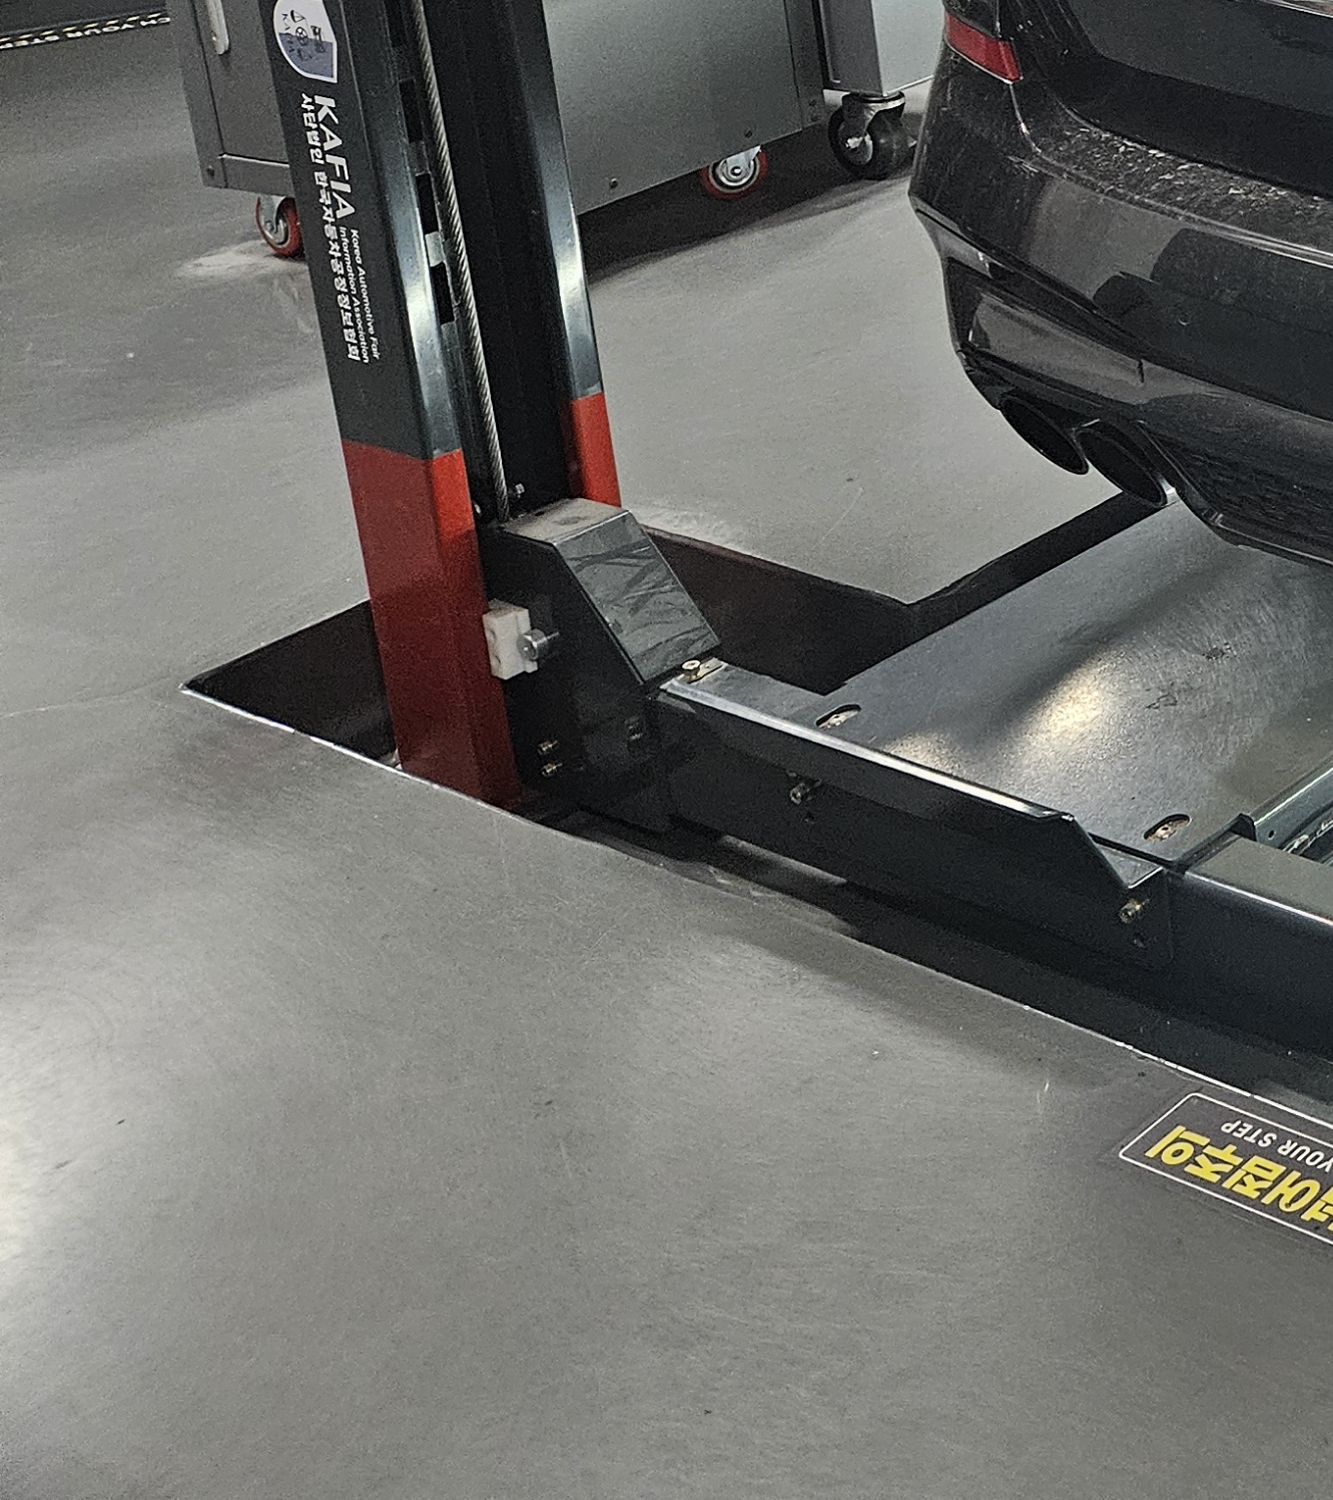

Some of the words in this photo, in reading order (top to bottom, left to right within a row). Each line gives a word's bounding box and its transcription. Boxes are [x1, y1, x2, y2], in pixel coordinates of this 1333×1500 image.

[314, 95, 356, 219] KAFIA
[301, 92, 325, 165] 사단법인
[314, 171, 361, 361] 한국자동차공정정보협회
[339, 226, 357, 294] Information
[352, 296, 370, 363] Association
[350, 229, 363, 264] Korea
[357, 266, 375, 335] Automotive
[370, 336, 380, 360] Fair
[1220, 1119, 1277, 1149] STEP
